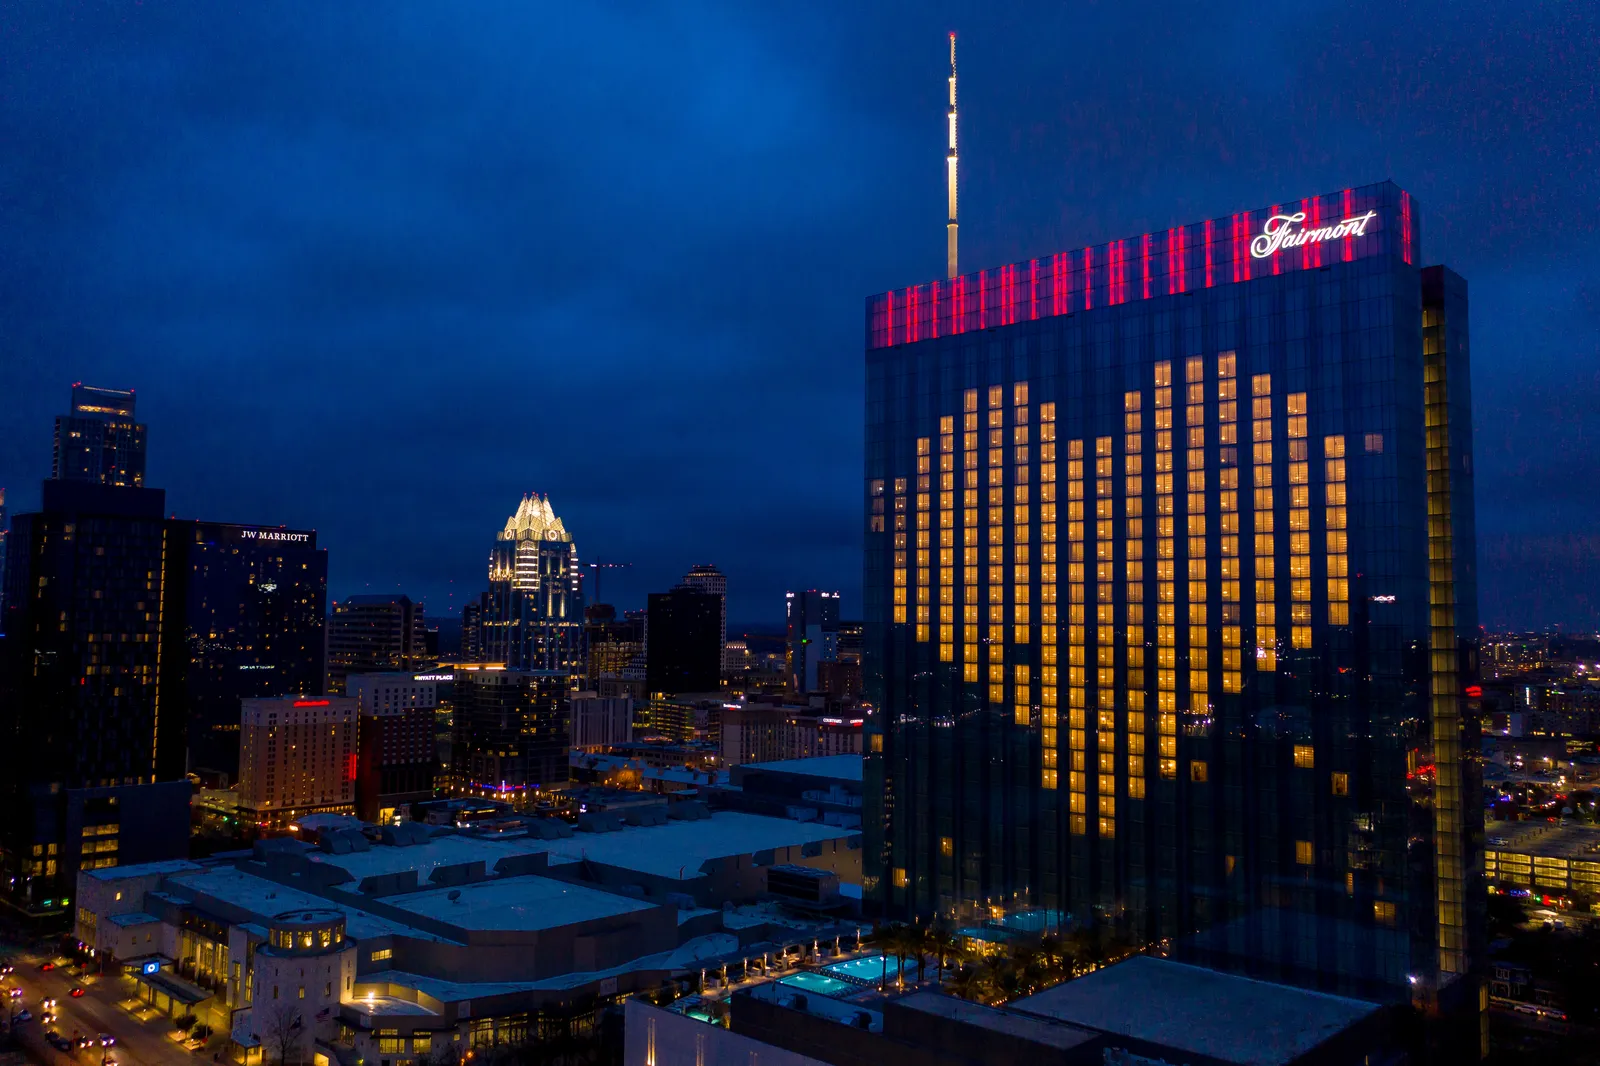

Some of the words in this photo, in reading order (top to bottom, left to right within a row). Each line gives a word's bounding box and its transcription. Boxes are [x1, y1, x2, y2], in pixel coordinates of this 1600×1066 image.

[1250, 210, 1377, 258] Fairmont
[241, 530, 257, 539] JW
[258, 531, 309, 542] MARRIOTT
